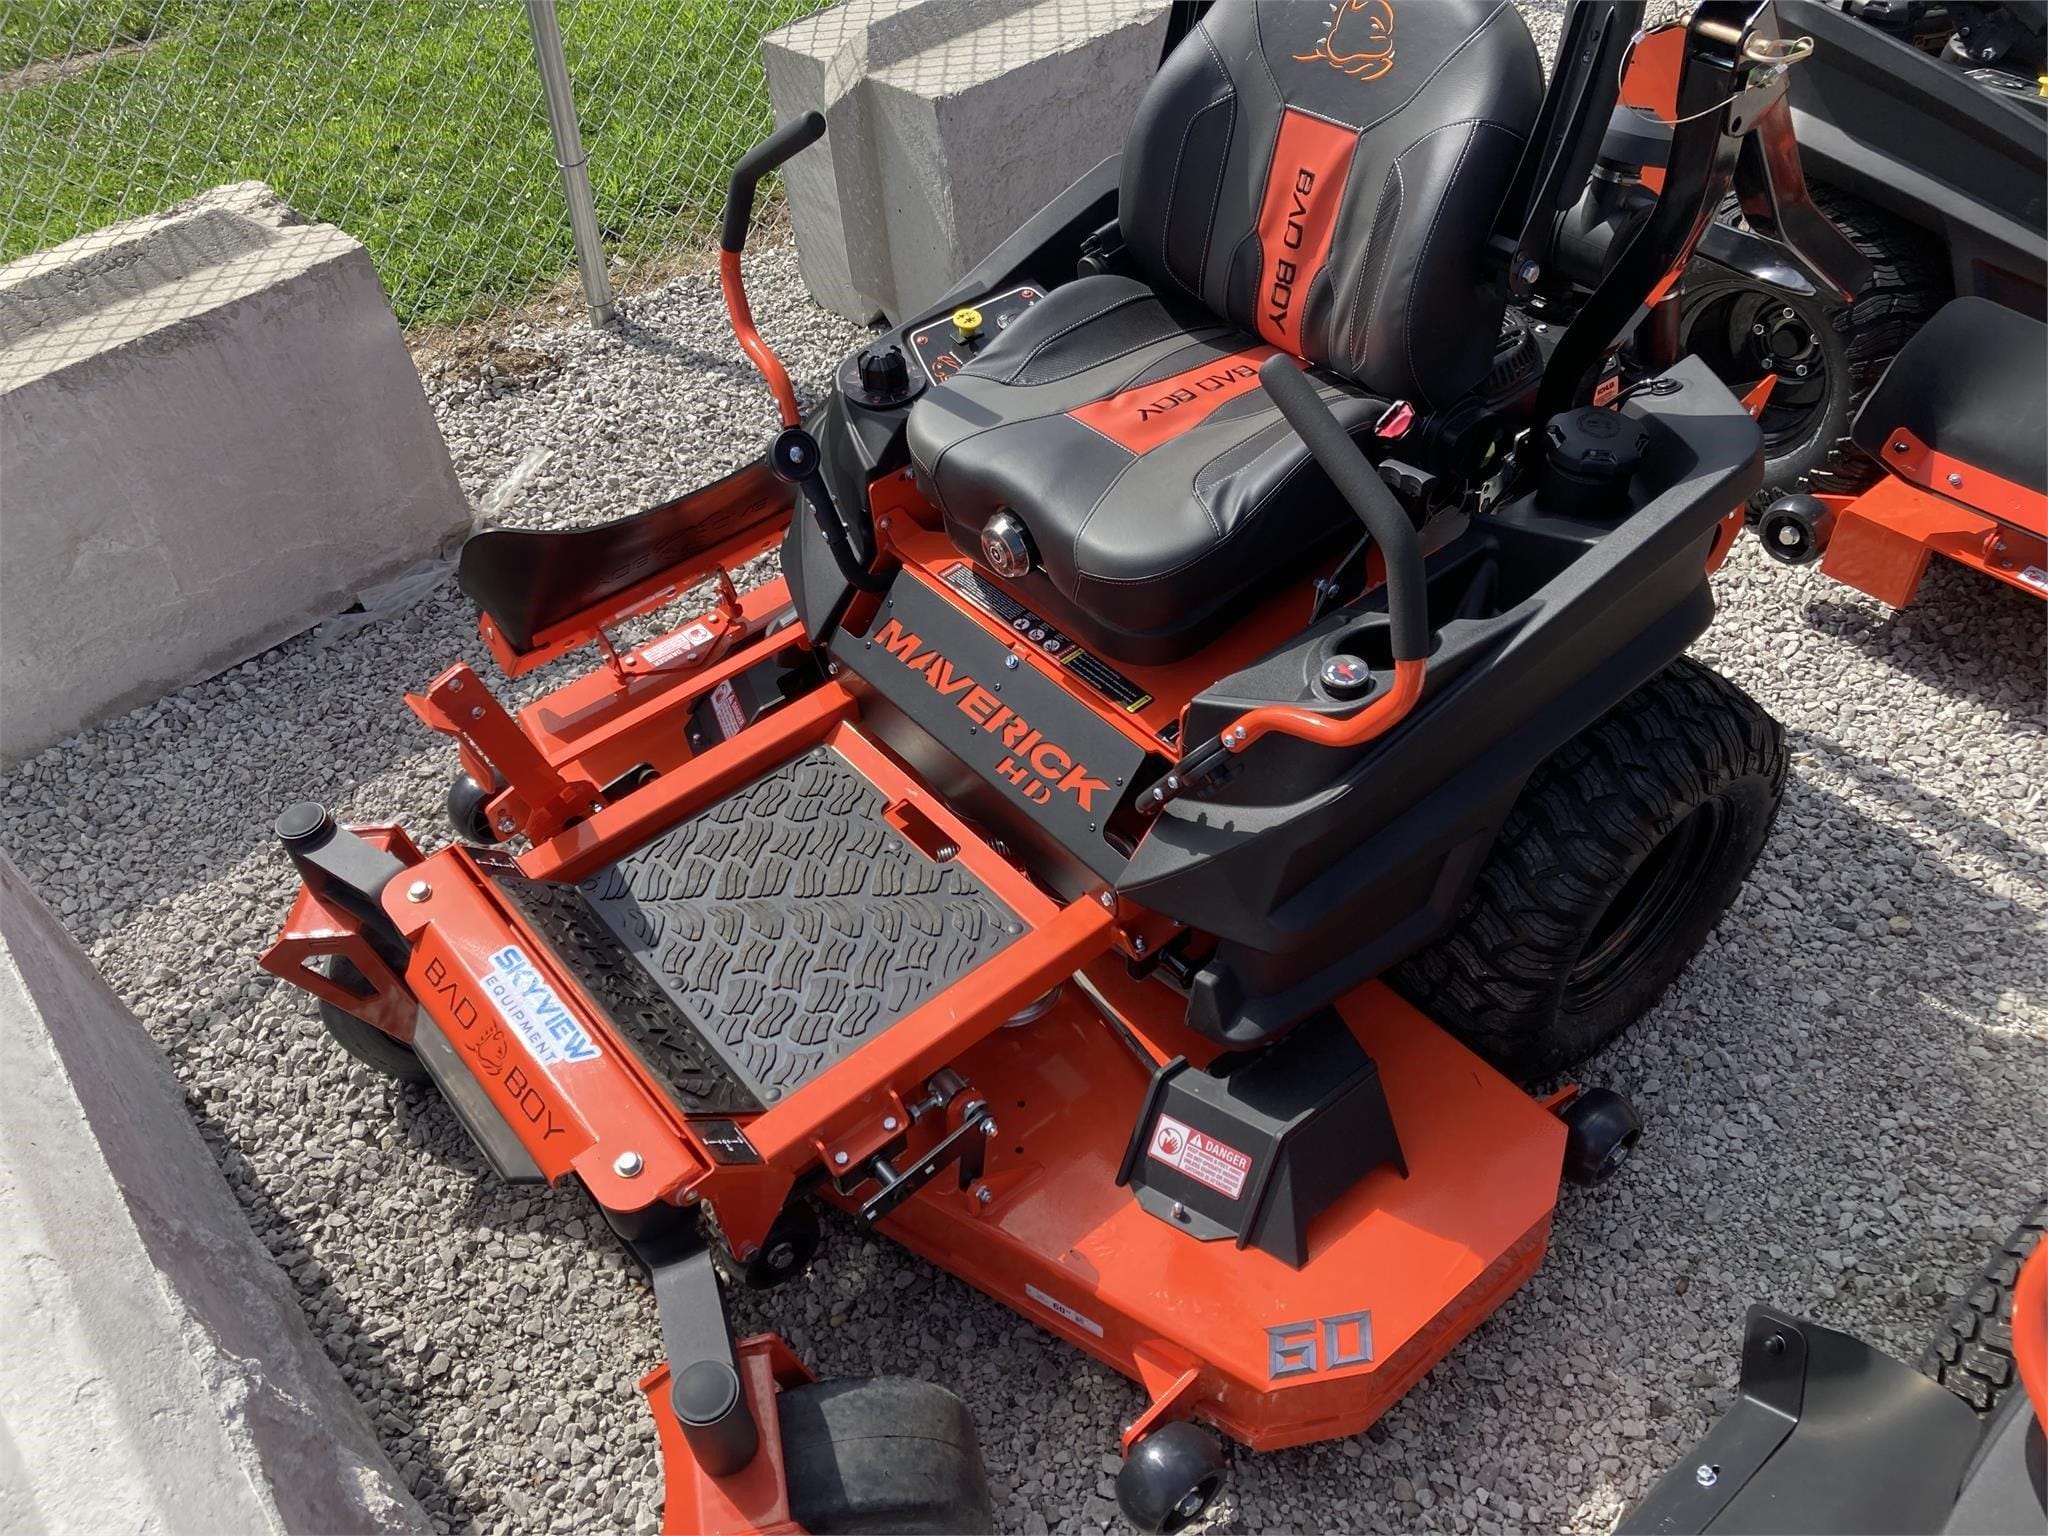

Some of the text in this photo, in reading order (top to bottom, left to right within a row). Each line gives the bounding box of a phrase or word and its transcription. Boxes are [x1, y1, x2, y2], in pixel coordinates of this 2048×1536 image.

[1268, 167, 1315, 336] BAD BOY
[1136, 364, 1259, 421] BAD BOY
[873, 617, 1111, 813] MAVERICK
[995, 755, 1050, 805] HD
[485, 975, 558, 1062] EQUIPMENT
[494, 947, 597, 1060] SKYVIEW
[424, 956, 566, 1141] BAD BOY
[1205, 1140, 1248, 1170] DANGER
[1263, 1309, 1374, 1381] 60
